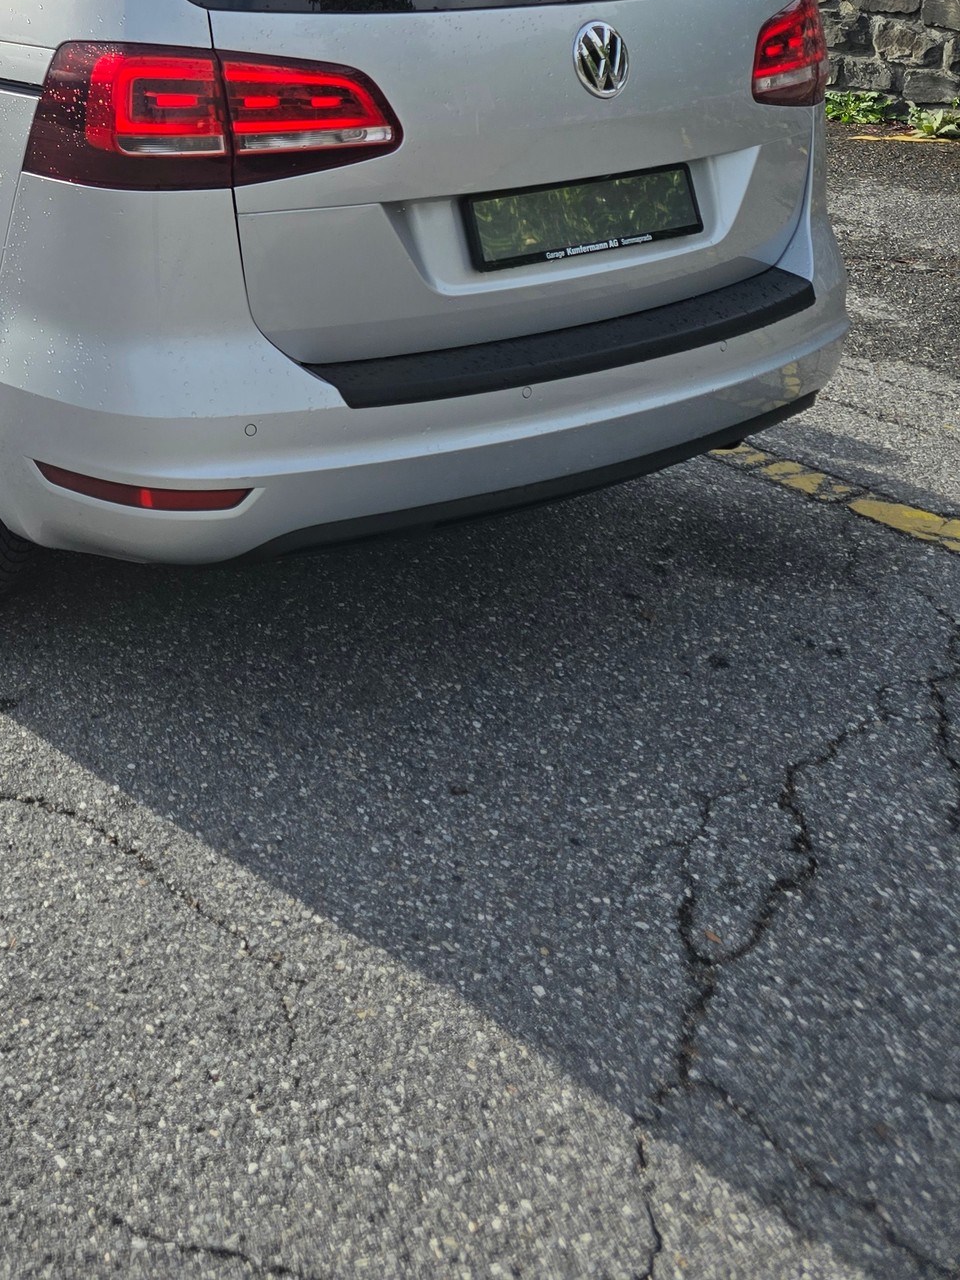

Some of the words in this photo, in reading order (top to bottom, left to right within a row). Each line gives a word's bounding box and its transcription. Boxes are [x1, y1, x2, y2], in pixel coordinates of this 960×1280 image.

[575, 22, 628, 96] VW
[545, 250, 566, 260] Garage
[608, 238, 619, 249] AG
